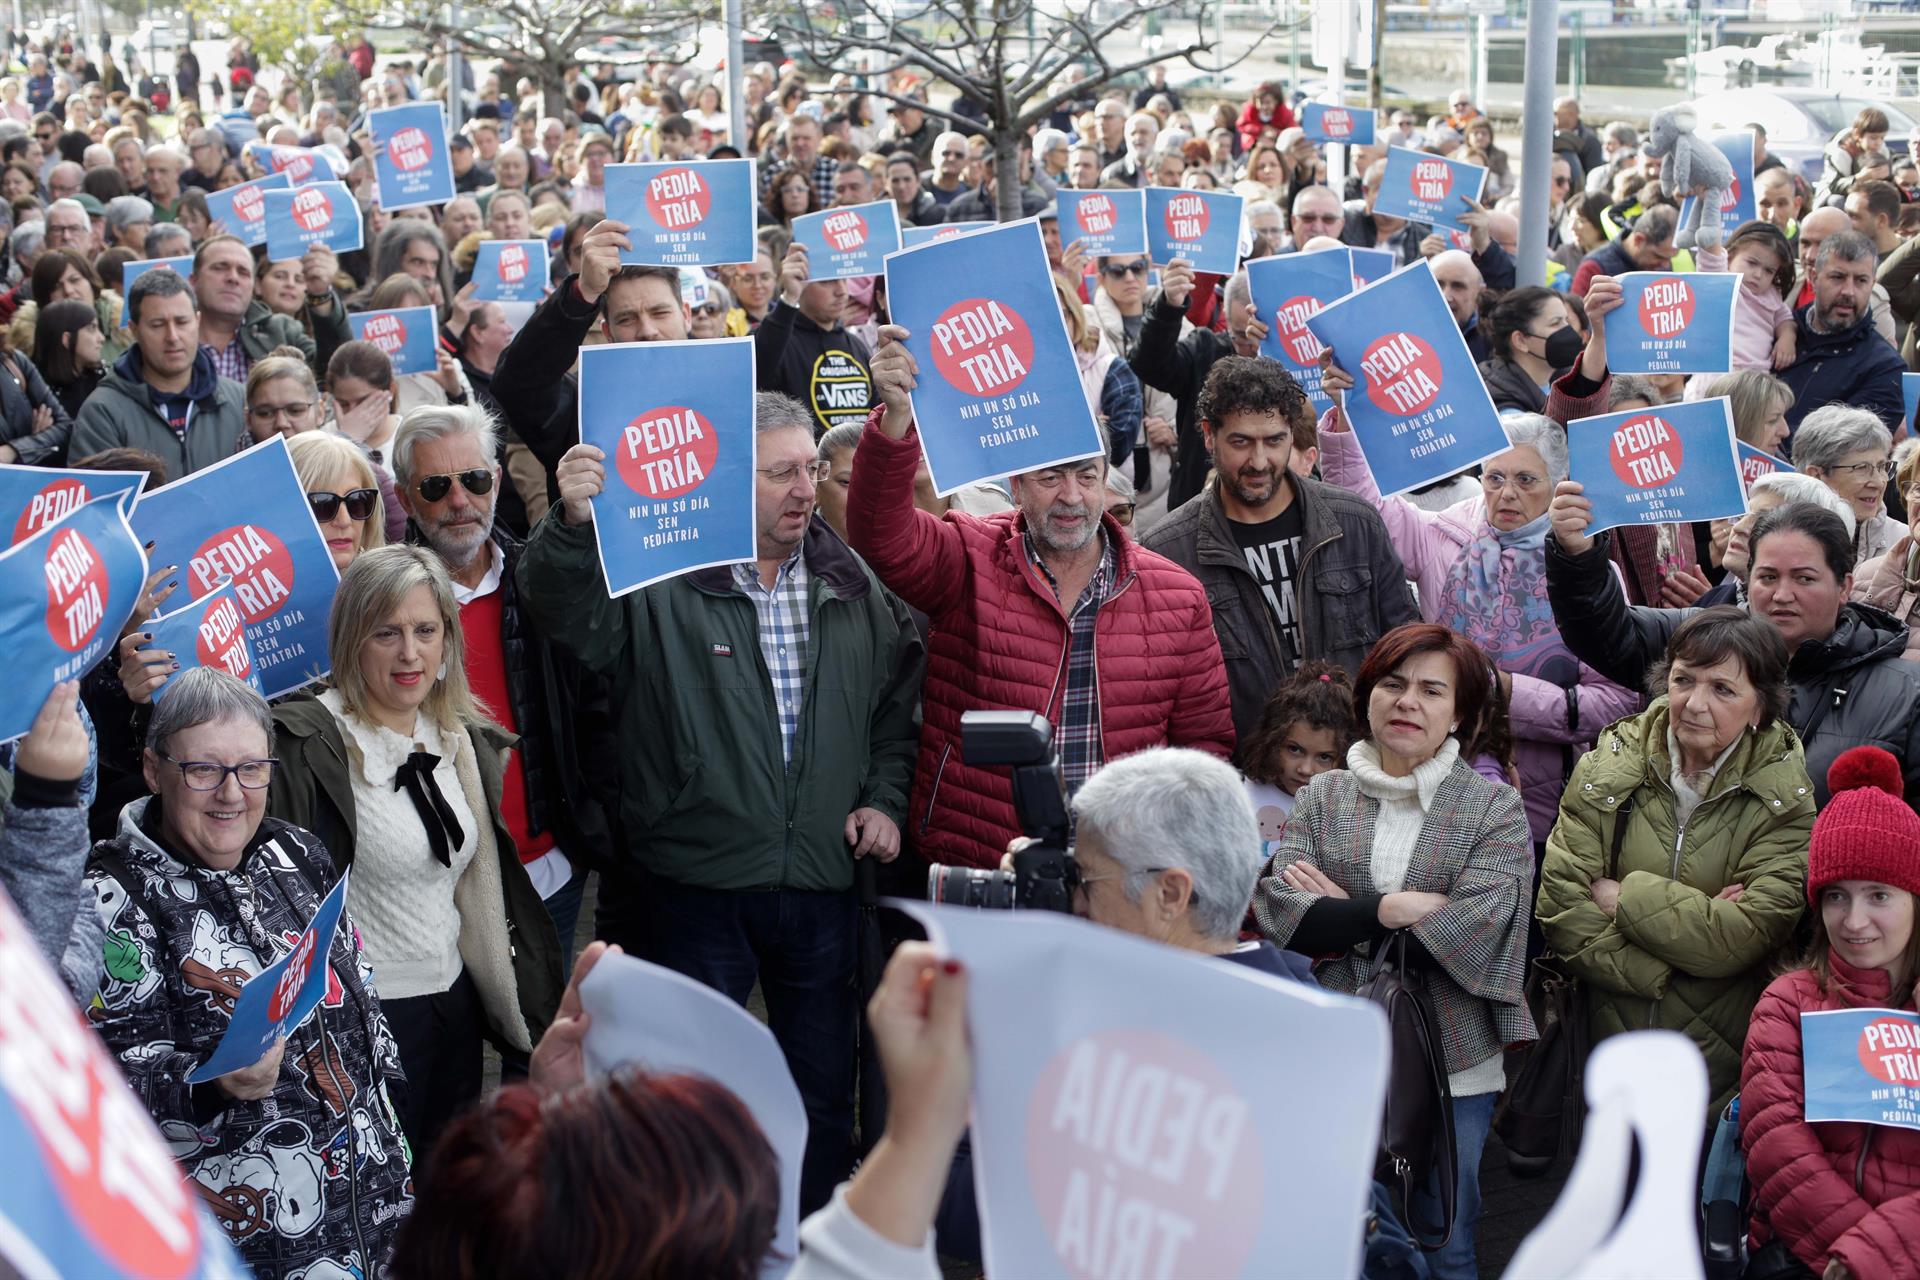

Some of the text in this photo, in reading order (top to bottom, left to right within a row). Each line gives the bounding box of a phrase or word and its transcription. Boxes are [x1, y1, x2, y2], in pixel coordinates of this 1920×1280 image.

[1416, 162, 1448, 180] PEDIA
[650, 170, 702, 201] PEDIA
[294, 188, 326, 213] PEDIA
[660, 197, 703, 227] TRÍA
[1079, 195, 1111, 216] PEDIA
[1169, 196, 1204, 218] PEDIA
[824, 211, 861, 234] PEDIA
[1644, 280, 1688, 310] PEDIA
[365, 315, 400, 337] PEDIA
[932, 300, 1015, 356] PEDIA
[1651, 306, 1685, 335] TRÍA
[820, 366, 861, 376] ORIGINAL
[828, 356, 847, 366] THE
[960, 342, 1027, 393] TRÍA
[1361, 332, 1423, 386] PEDIA
[820, 382, 869, 408] VANS
[1384, 367, 1439, 413] TRÍA
[960, 391, 1040, 420] NIN UN SÓ DÍA
[624, 409, 704, 459] PEDIA
[992, 414, 1013, 430] SEN
[1391, 403, 1454, 438] NIN UN SÓ DÍA
[1418, 426, 1435, 441] SEN
[980, 424, 1039, 448] PEDIATRÍA
[1410, 432, 1457, 459] PEDIATRÍA
[1613, 417, 1670, 458] PEDIA
[640, 449, 705, 495] TRÍA
[1627, 448, 1676, 486] TRÍA
[27, 485, 87, 530] PEDIA
[629, 496, 710, 520] NIN UN SÓ DÍA
[1625, 493, 1641, 503] NIN
[1643, 490, 1655, 500] UN
[1669, 486, 1685, 497] DÍA
[1649, 500, 1665, 509] SEN
[657, 516, 678, 530] SEN
[1640, 508, 1682, 521] PEDIATRÍA
[643, 527, 699, 550] PEDIATRÍA
[44, 528, 94, 606] PEDIA
[189, 524, 272, 590] PEDIA
[234, 567, 289, 621] RÍA
[64, 580, 103, 647] TRÍA
[199, 597, 240, 653] PEDIA
[266, 619, 281, 635] SÓ
[285, 610, 305, 627] DÍA
[255, 643, 305, 671] EDIATRÍA
[256, 638, 279, 653] SEN
[279, 928, 314, 995] PEDIA
[1879, 1049, 1920, 1081] TRÍ
[1871, 1088, 1889, 1100] NIN
[1893, 1086, 1906, 1097] UN
[1897, 1099, 1915, 1110] SEN
[372, 1200, 414, 1226] LAWYE
